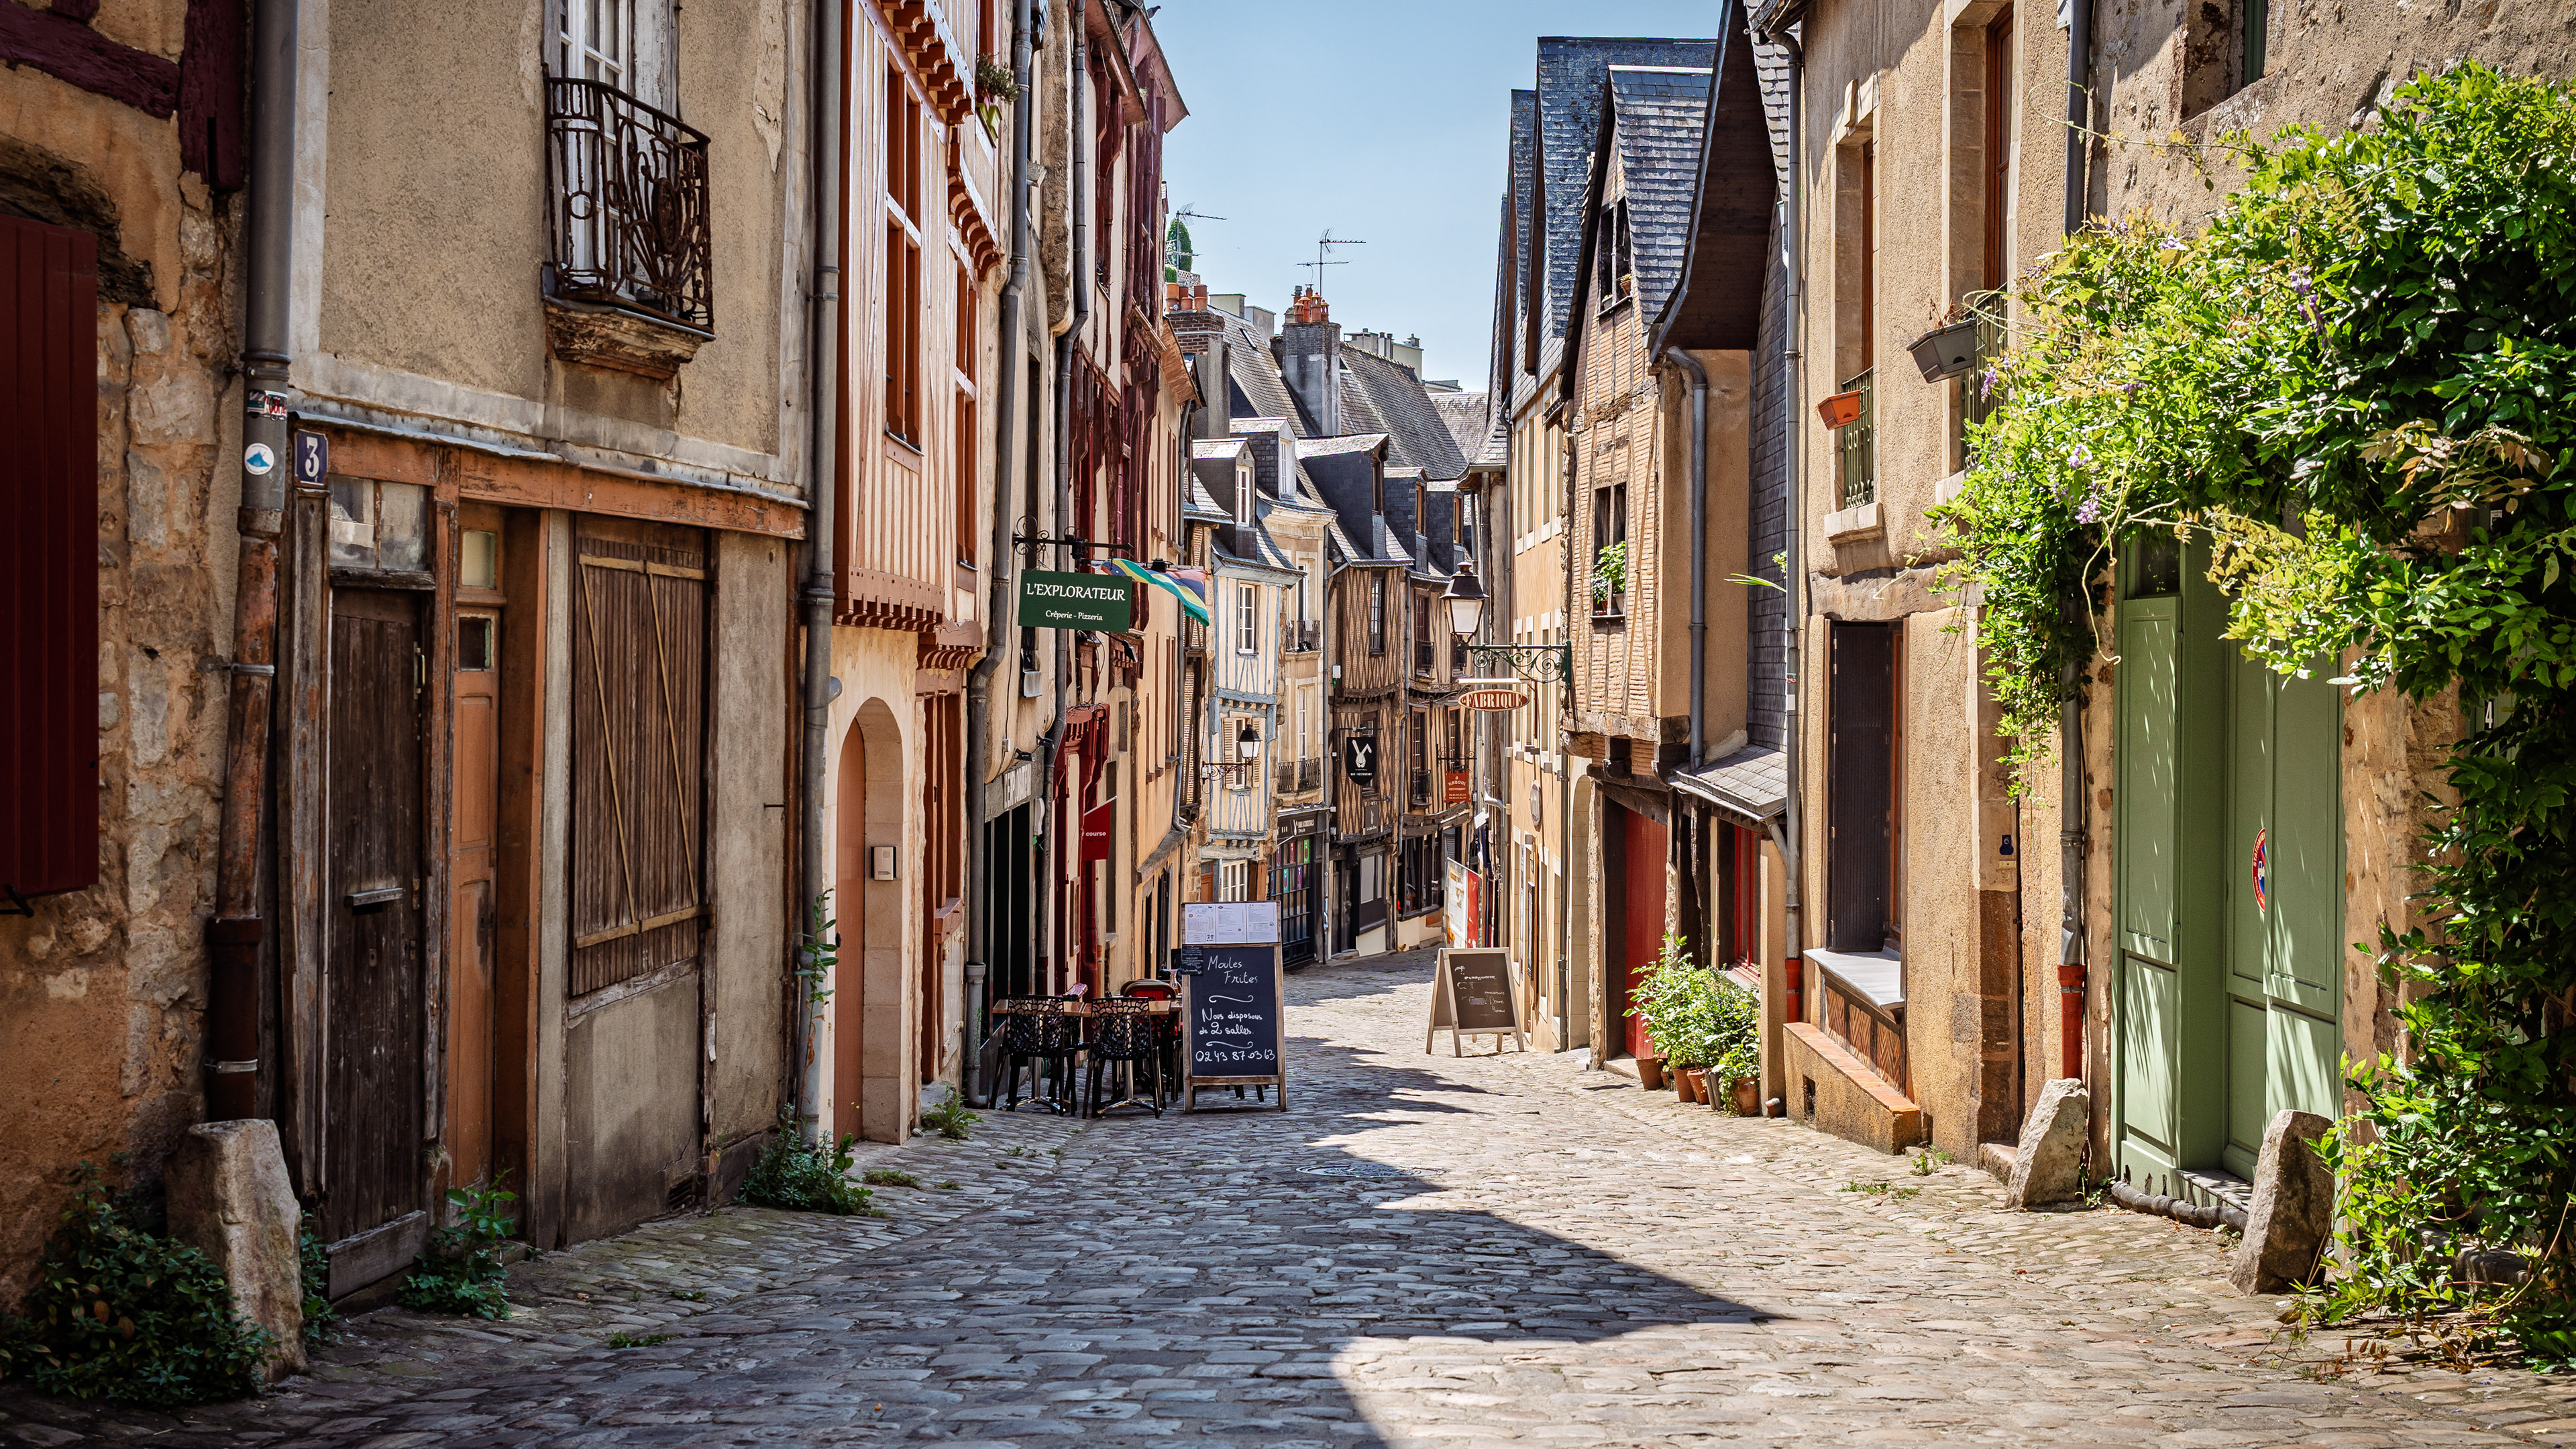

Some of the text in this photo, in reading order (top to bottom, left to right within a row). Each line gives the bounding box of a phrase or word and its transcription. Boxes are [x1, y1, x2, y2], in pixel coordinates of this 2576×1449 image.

[305, 437, 319, 477] 3
[1026, 583, 1126, 601] L'EXPLORATEUR
[1045, 610, 1073, 620] Crêperie
[1077, 612, 1104, 621] Pizzeria
[1466, 693, 1523, 708] FABRIQUE
[2485, 701, 2493, 729] 4
[2004, 837, 2010, 845] 6
[1208, 955, 1242, 971] Moules
[1224, 970, 1258, 984] Frites
[1201, 1008, 1263, 1022] Nous disposons
[1199, 1026, 1209, 1035] de
[1210, 1022, 1223, 1035] 2
[1195, 1051, 1213, 1063] 02
[1214, 1051, 1228, 1063] 43
[1232, 1051, 1246, 1061] 87
[1264, 1049, 1275, 1061] 63
